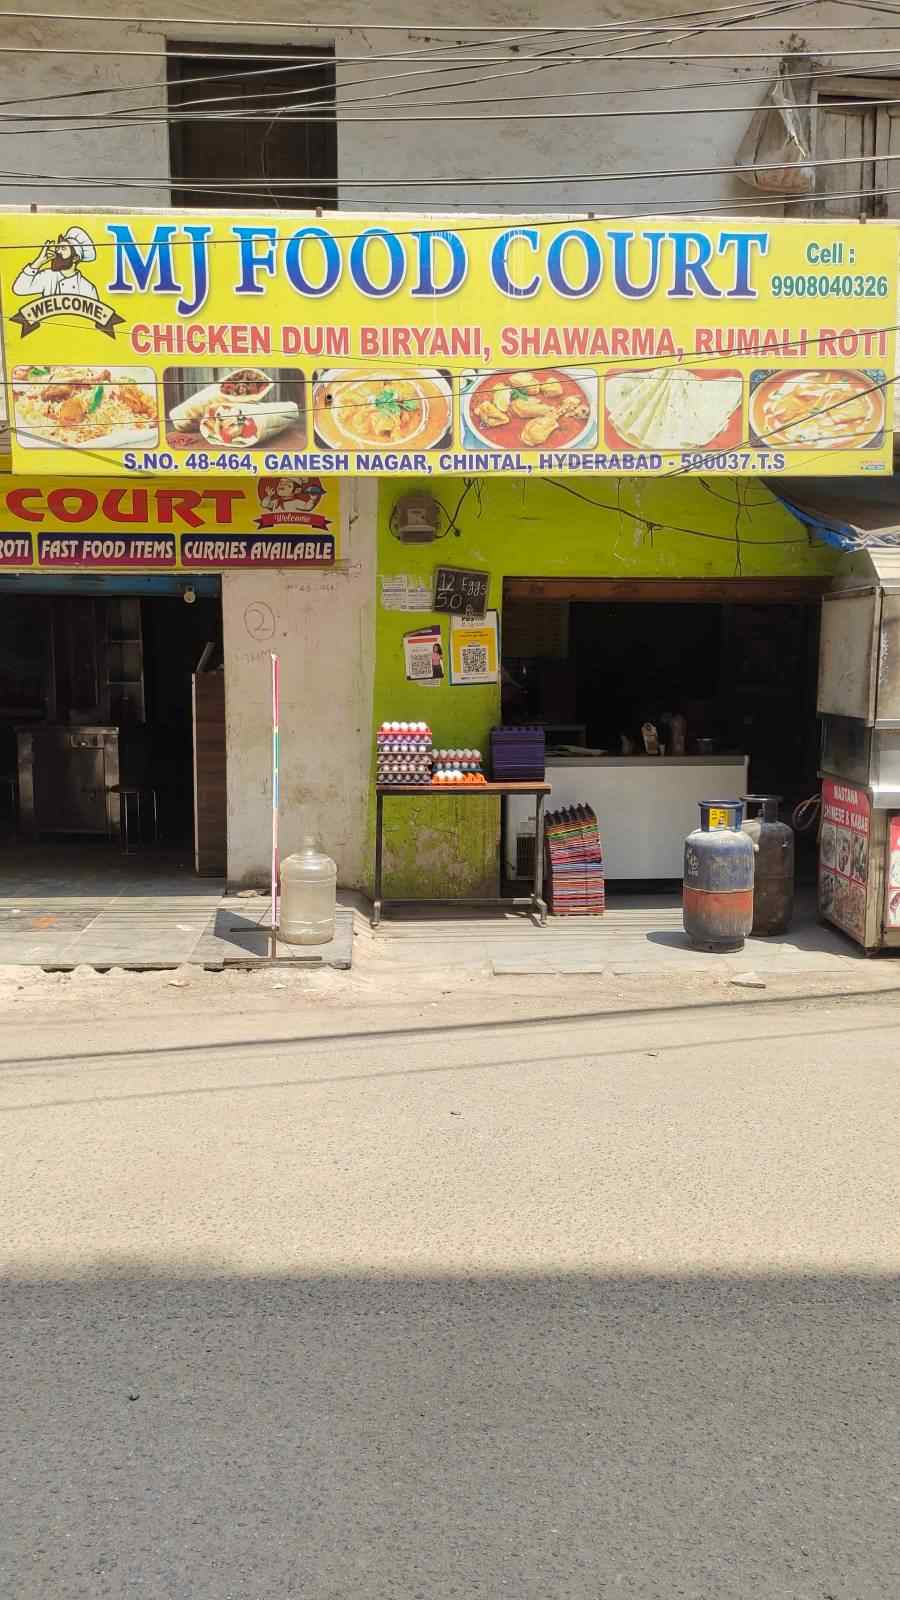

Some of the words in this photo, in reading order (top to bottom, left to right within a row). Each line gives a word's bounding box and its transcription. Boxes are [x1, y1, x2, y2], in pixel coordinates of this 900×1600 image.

[807, 242, 843, 264] Cell
[106, 224, 213, 316] MJ
[232, 227, 468, 298] FOOD
[490, 228, 768, 300] COURT
[771, 275, 888, 297] 9908040326
[31, 297, 103, 318] WELCOME
[131, 324, 271, 354] CHICKEN
[282, 326, 350, 355] DUM
[360, 327, 491, 361] BIRYANI,
[501, 327, 684, 361] SHAWARMA,
[695, 328, 808, 357] RUMALI
[819, 328, 887, 357] ROTI
[124, 453, 178, 470] S.NO.
[185, 453, 258, 473] 48-464,
[264, 454, 349, 471] GANESH
[356, 454, 432, 473] NAGAR,
[439, 454, 532, 472] CHINTAL,
[540, 454, 663, 471] HYDERABAD
[6, 488, 246, 527] COURT
[42, 541, 78, 559] FAST
[83, 541, 126, 559] FOOD
[130, 541, 174, 559] ITEMS
[184, 540, 247, 559] CURRIES
[250, 541, 332, 560] AVAILABLE
[438, 573, 455, 591] 12
